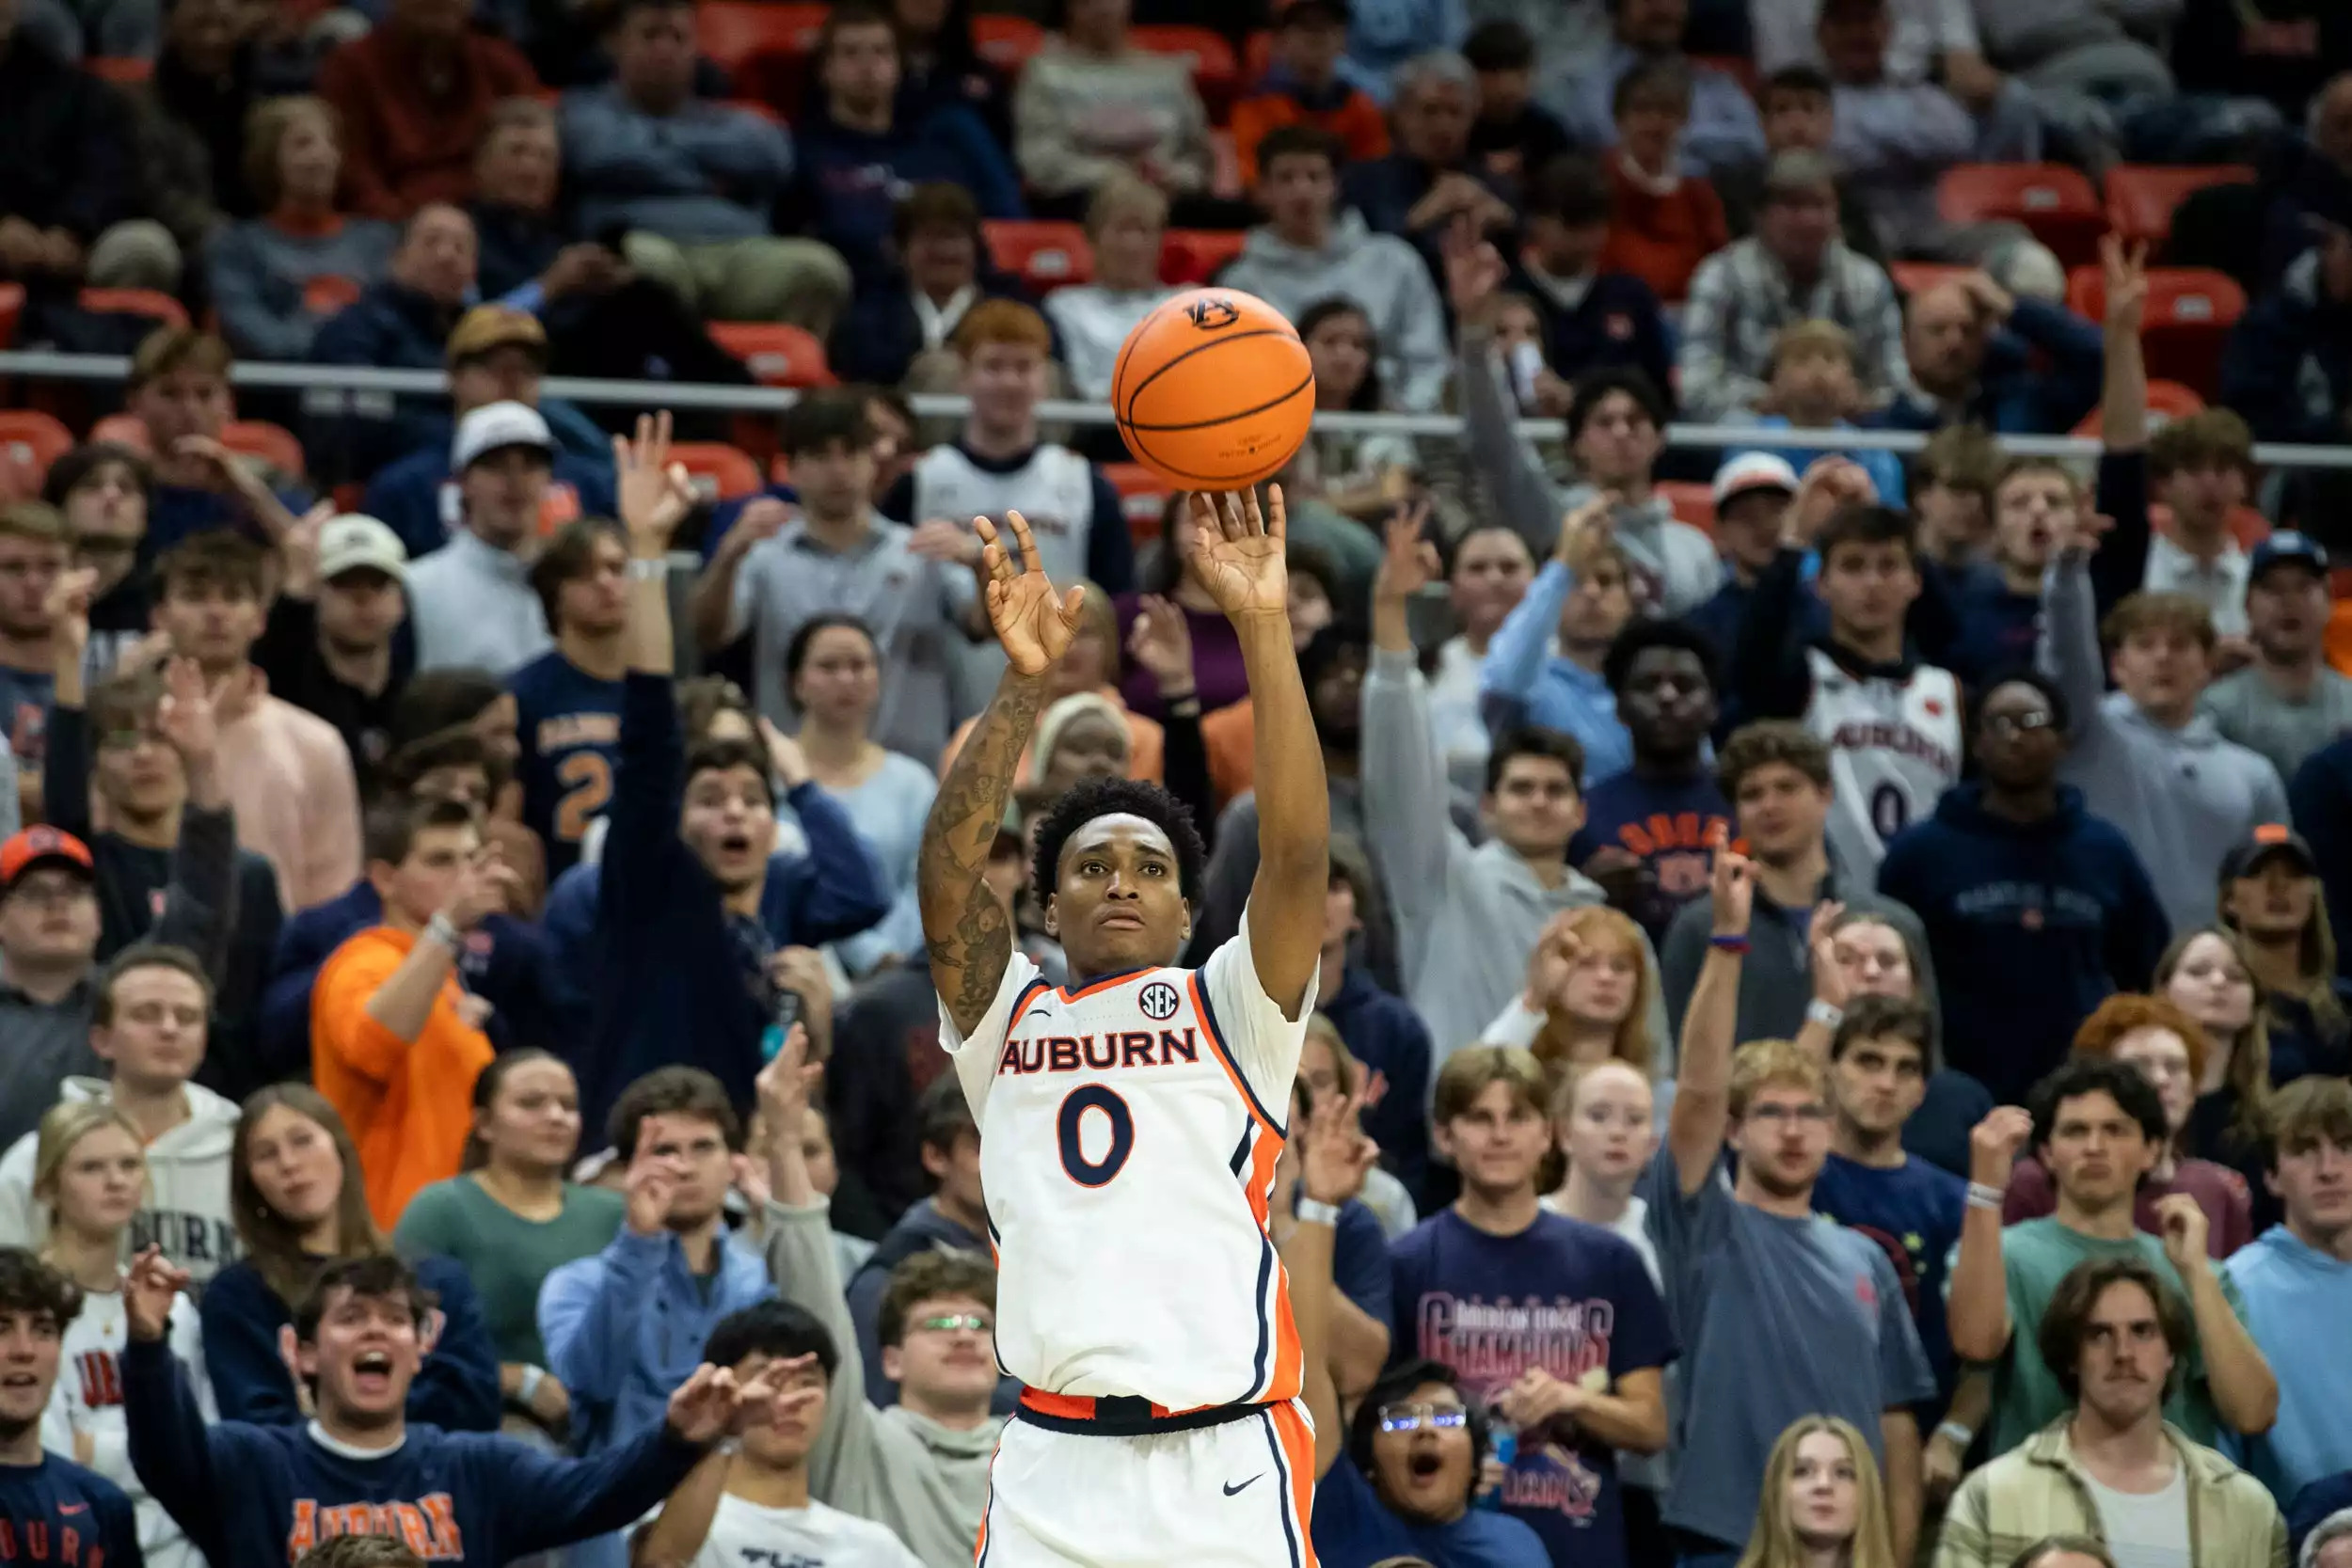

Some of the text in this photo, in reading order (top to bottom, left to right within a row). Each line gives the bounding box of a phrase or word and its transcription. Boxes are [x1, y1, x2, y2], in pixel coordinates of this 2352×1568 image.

[552, 750, 613, 843] 2
[1140, 983, 1179, 1020] SEC
[998, 1027, 1200, 1075] AUBURN
[1057, 1083, 1136, 1188] 0
